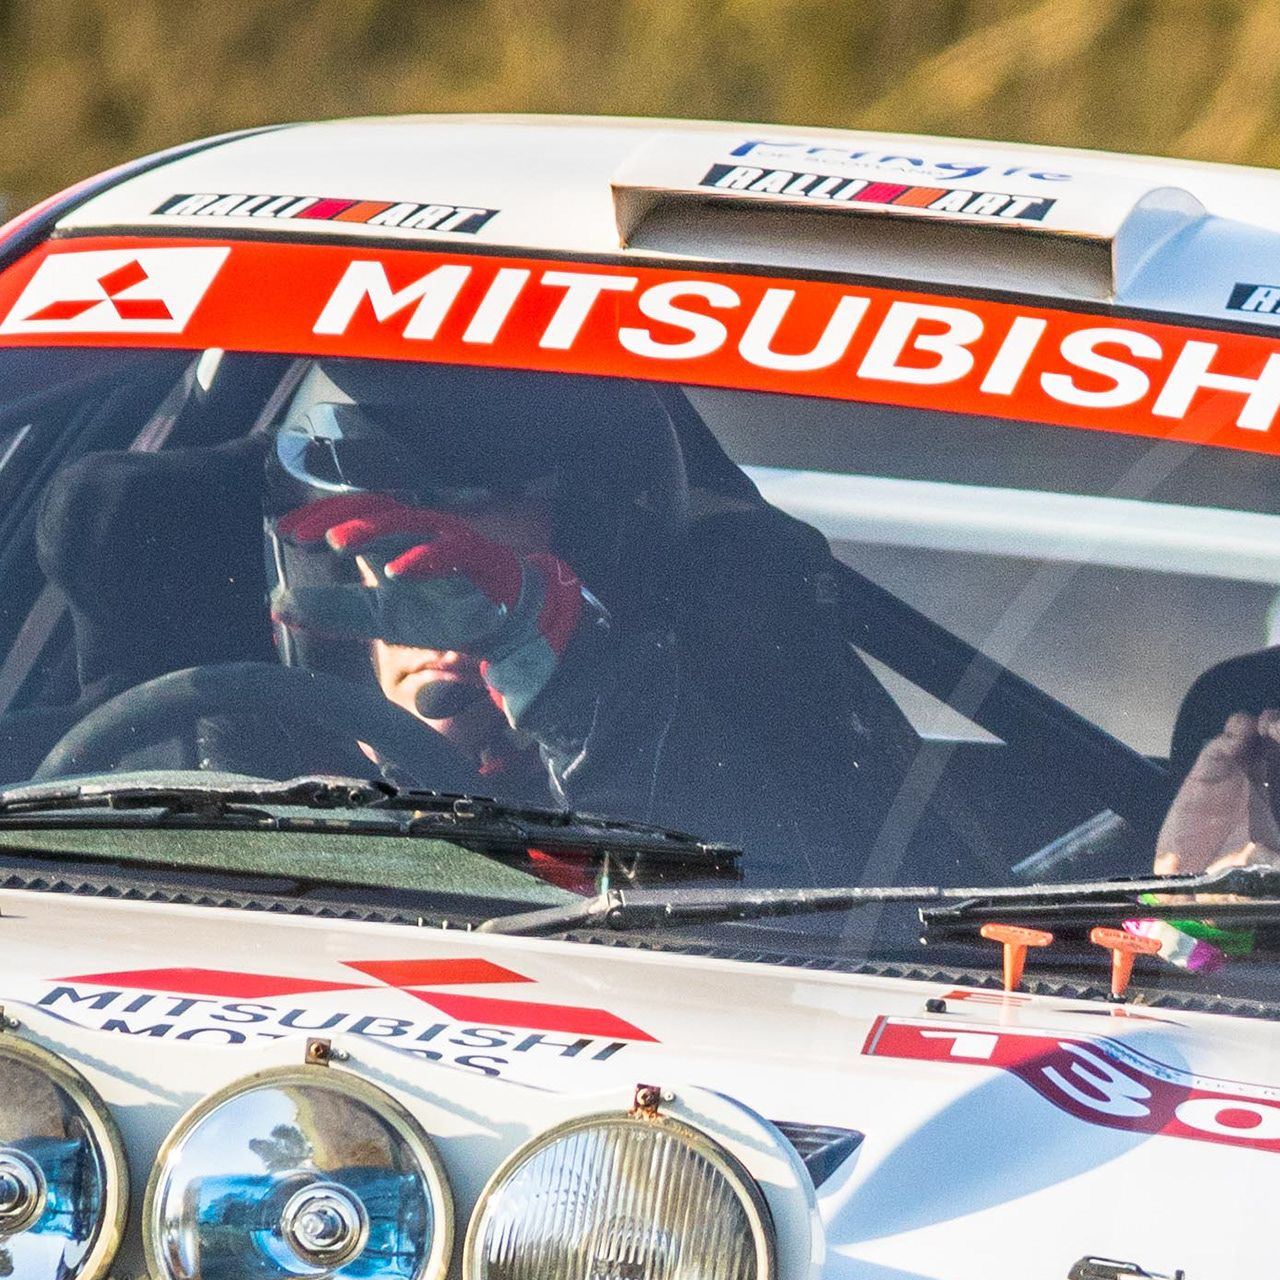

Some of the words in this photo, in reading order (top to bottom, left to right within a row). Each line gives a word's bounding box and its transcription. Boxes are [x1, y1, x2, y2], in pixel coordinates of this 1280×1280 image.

[163, 193, 321, 219] RALLI
[366, 203, 488, 232] ART
[715, 165, 870, 201] RALLI
[927, 189, 1055, 221] ART
[38, 985, 629, 1062] MITSUBISHI
